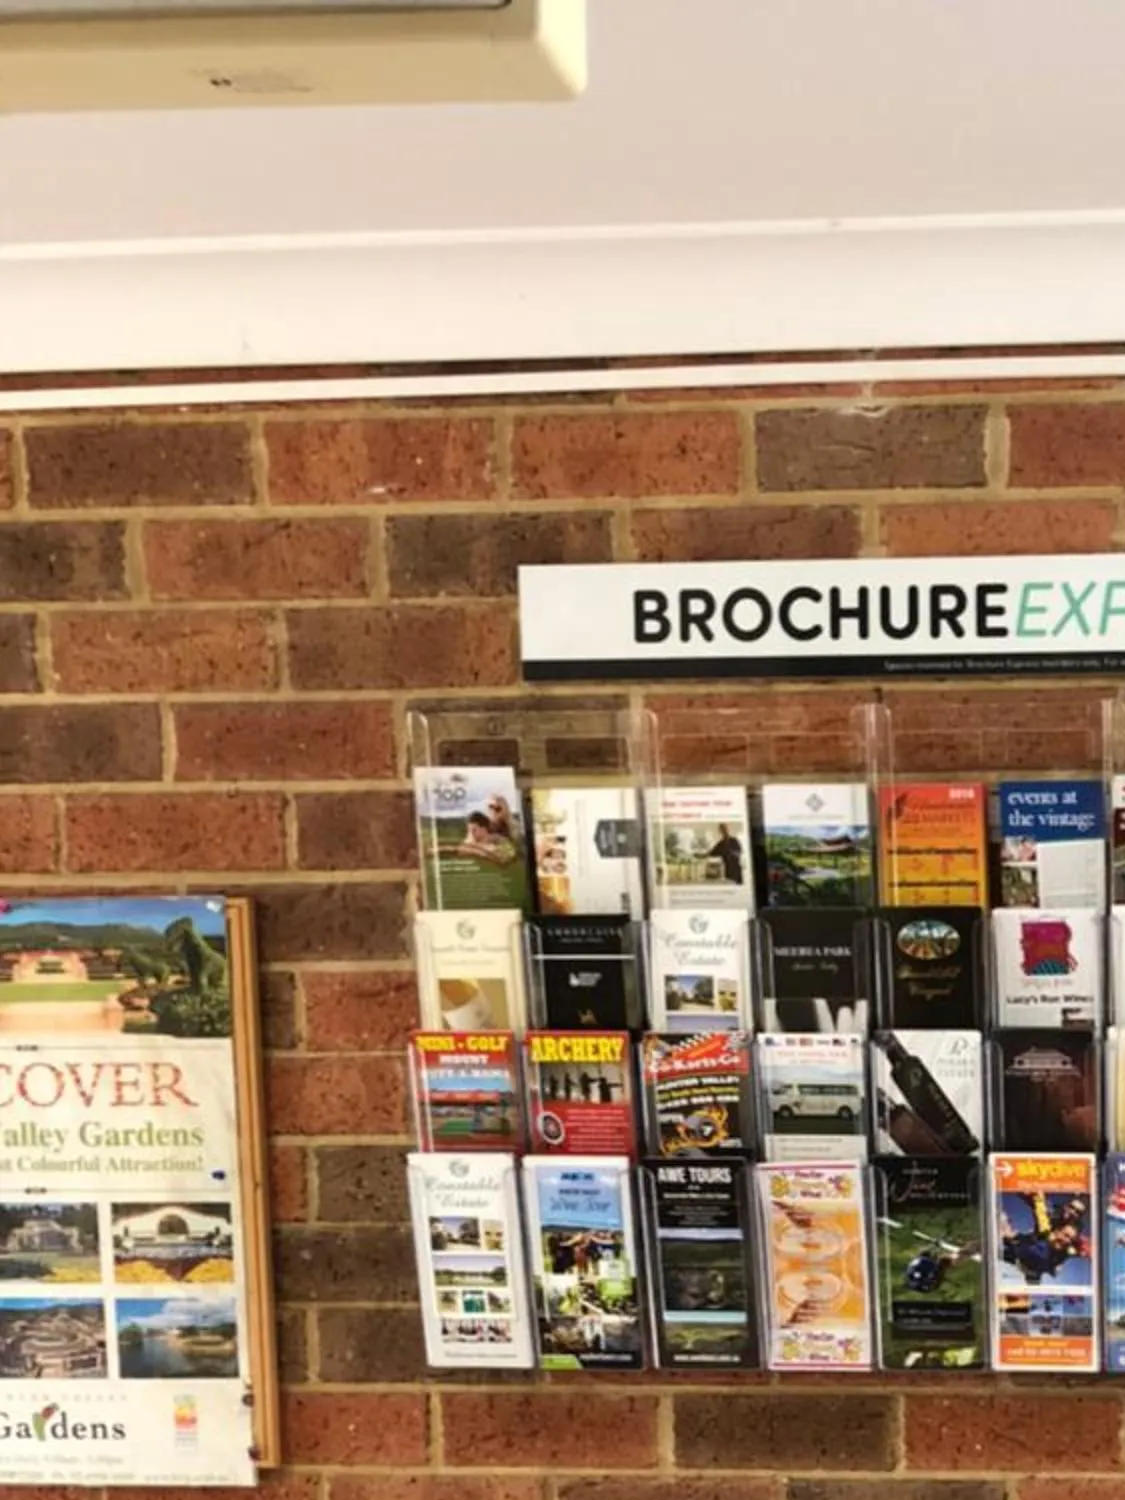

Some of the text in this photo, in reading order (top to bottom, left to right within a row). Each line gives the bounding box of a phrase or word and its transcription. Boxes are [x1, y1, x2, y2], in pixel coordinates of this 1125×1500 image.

[632, 583, 1009, 643] BROCHURE
[530, 1036, 625, 1063] ARCHERY
[0, 1119, 205, 1153] alley Gardens
[657, 1167, 732, 1184] AWE TOURS
